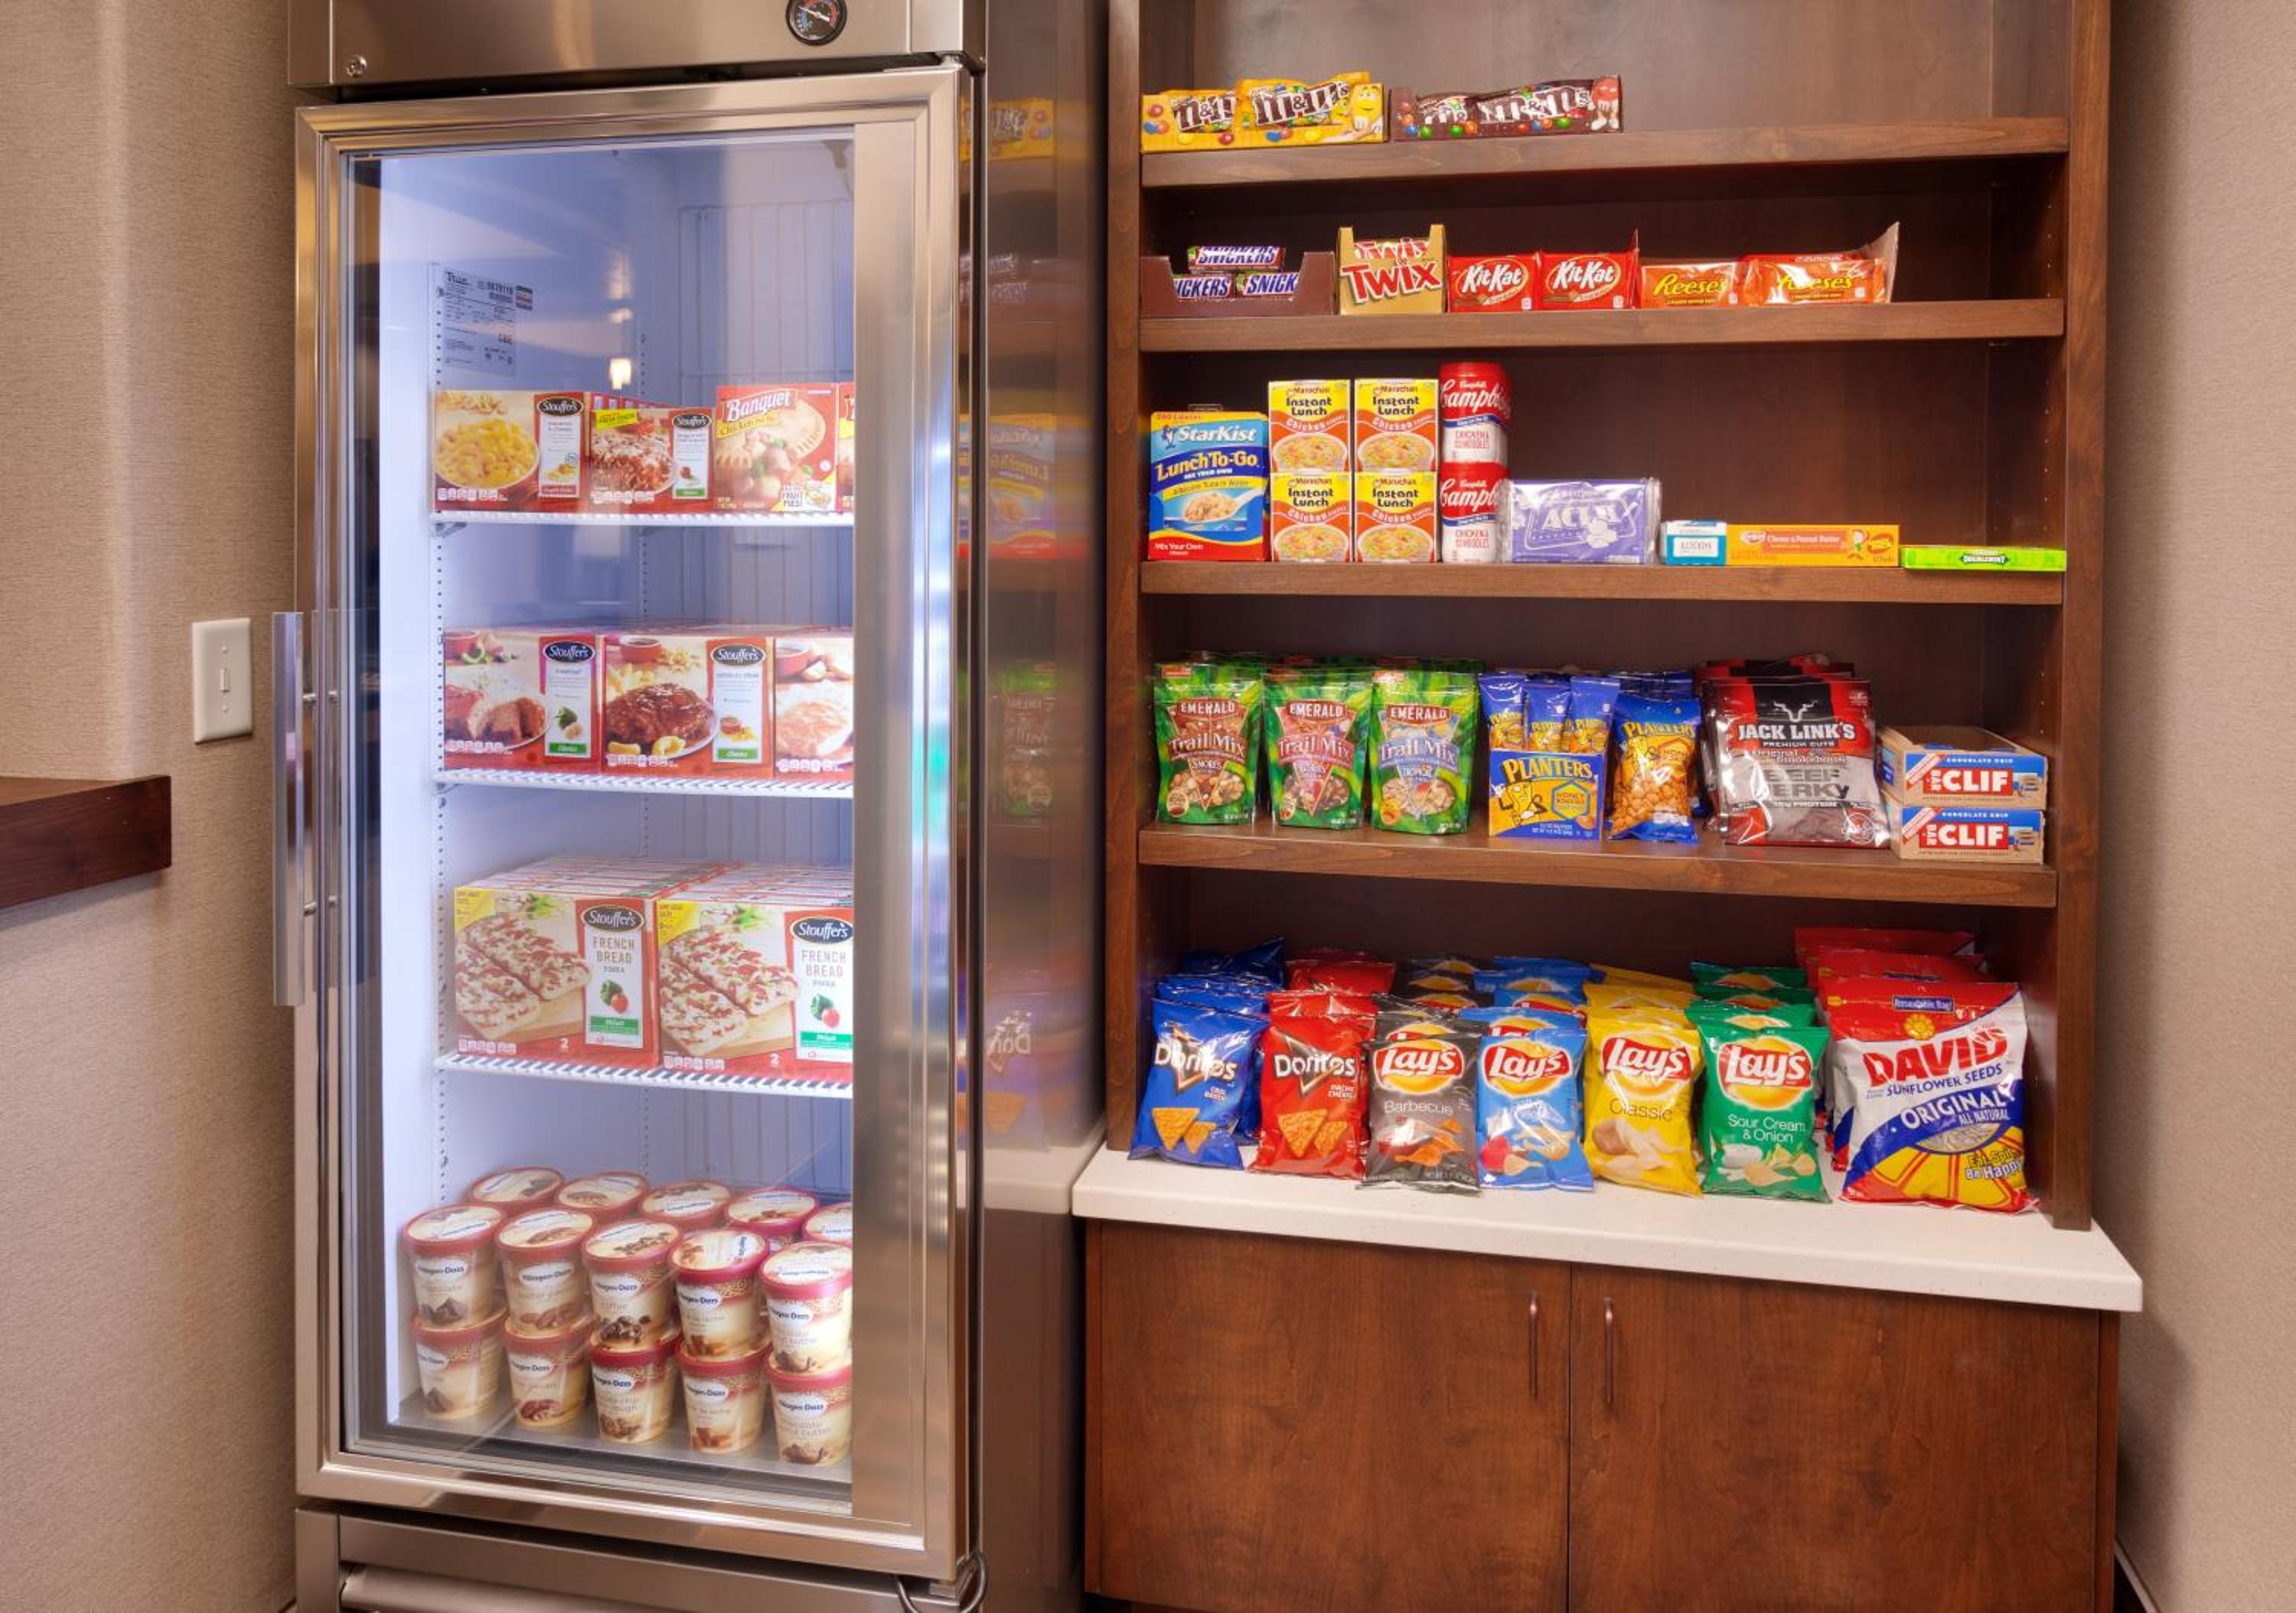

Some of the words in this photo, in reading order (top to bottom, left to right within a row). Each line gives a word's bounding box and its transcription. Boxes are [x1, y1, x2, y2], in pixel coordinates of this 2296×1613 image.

[1175, 276, 1229, 298] ICKERS
[1777, 274, 1853, 291] Rese's
[726, 390, 791, 422] Banquet
[1286, 396, 1332, 407] Instant
[1372, 396, 1420, 406] Instant
[1291, 406, 1328, 416] Lunch
[1378, 406, 1415, 416] Lunch
[1179, 425, 1257, 442] StarKist
[1288, 487, 1334, 498] Instant
[1372, 488, 1419, 499] Instant
[1293, 497, 1329, 508] Lunch
[1378, 498, 1414, 508] Lunch
[549, 644, 589, 660] Stouffer's
[717, 646, 760, 664] Stouffer's
[1180, 702, 1236, 715] EMERALD
[1289, 703, 1343, 718] EMERALD
[1390, 706, 1447, 720] EMERALD
[1738, 724, 1786, 741] JACK
[1790, 721, 1857, 741] LINK'S
[1169, 734, 1212, 753] Trail
[1213, 733, 1247, 757] Mix
[1279, 737, 1316, 757] Trail
[1322, 737, 1351, 761] Mix
[1502, 758, 1593, 783] PLANTERS
[1942, 770, 2009, 793] CLIF
[1764, 783, 1850, 800] ERKY
[1938, 823, 2004, 846] CLIF
[588, 909, 638, 929] Stouffer's
[798, 921, 849, 941] Stouffer's
[592, 936, 635, 950] FRENCH
[595, 950, 633, 964] BREAD
[801, 950, 846, 963] FRENCH
[805, 965, 843, 978] BREAD
[770, 1053, 780, 1064] 2
[1274, 1053, 1355, 1078] Doritos
[1381, 1047, 1457, 1077] Lay's
[1489, 1047, 1564, 1081] Lay's
[1606, 1038, 1688, 1080] Lay's
[1726, 1045, 1807, 1087] Lay's
[1861, 1028, 2009, 1088] DAVID
[1887, 1077, 1962, 1097] SUNFLOWER
[1964, 1063, 2003, 1084] SEEDS
[1384, 1100, 1454, 1116] Barbecue
[1609, 1097, 1673, 1123] Classic
[1900, 1090, 2007, 1130] ORIGINAL
[1727, 1113, 1759, 1129] Sour
[1763, 1116, 1805, 1132] Cream
[1958, 1113, 1972, 1126] ALL
[1973, 1109, 2011, 1124] NATURAL
[1743, 1130, 1751, 1140] &
[1753, 1129, 1794, 1144] Onion
